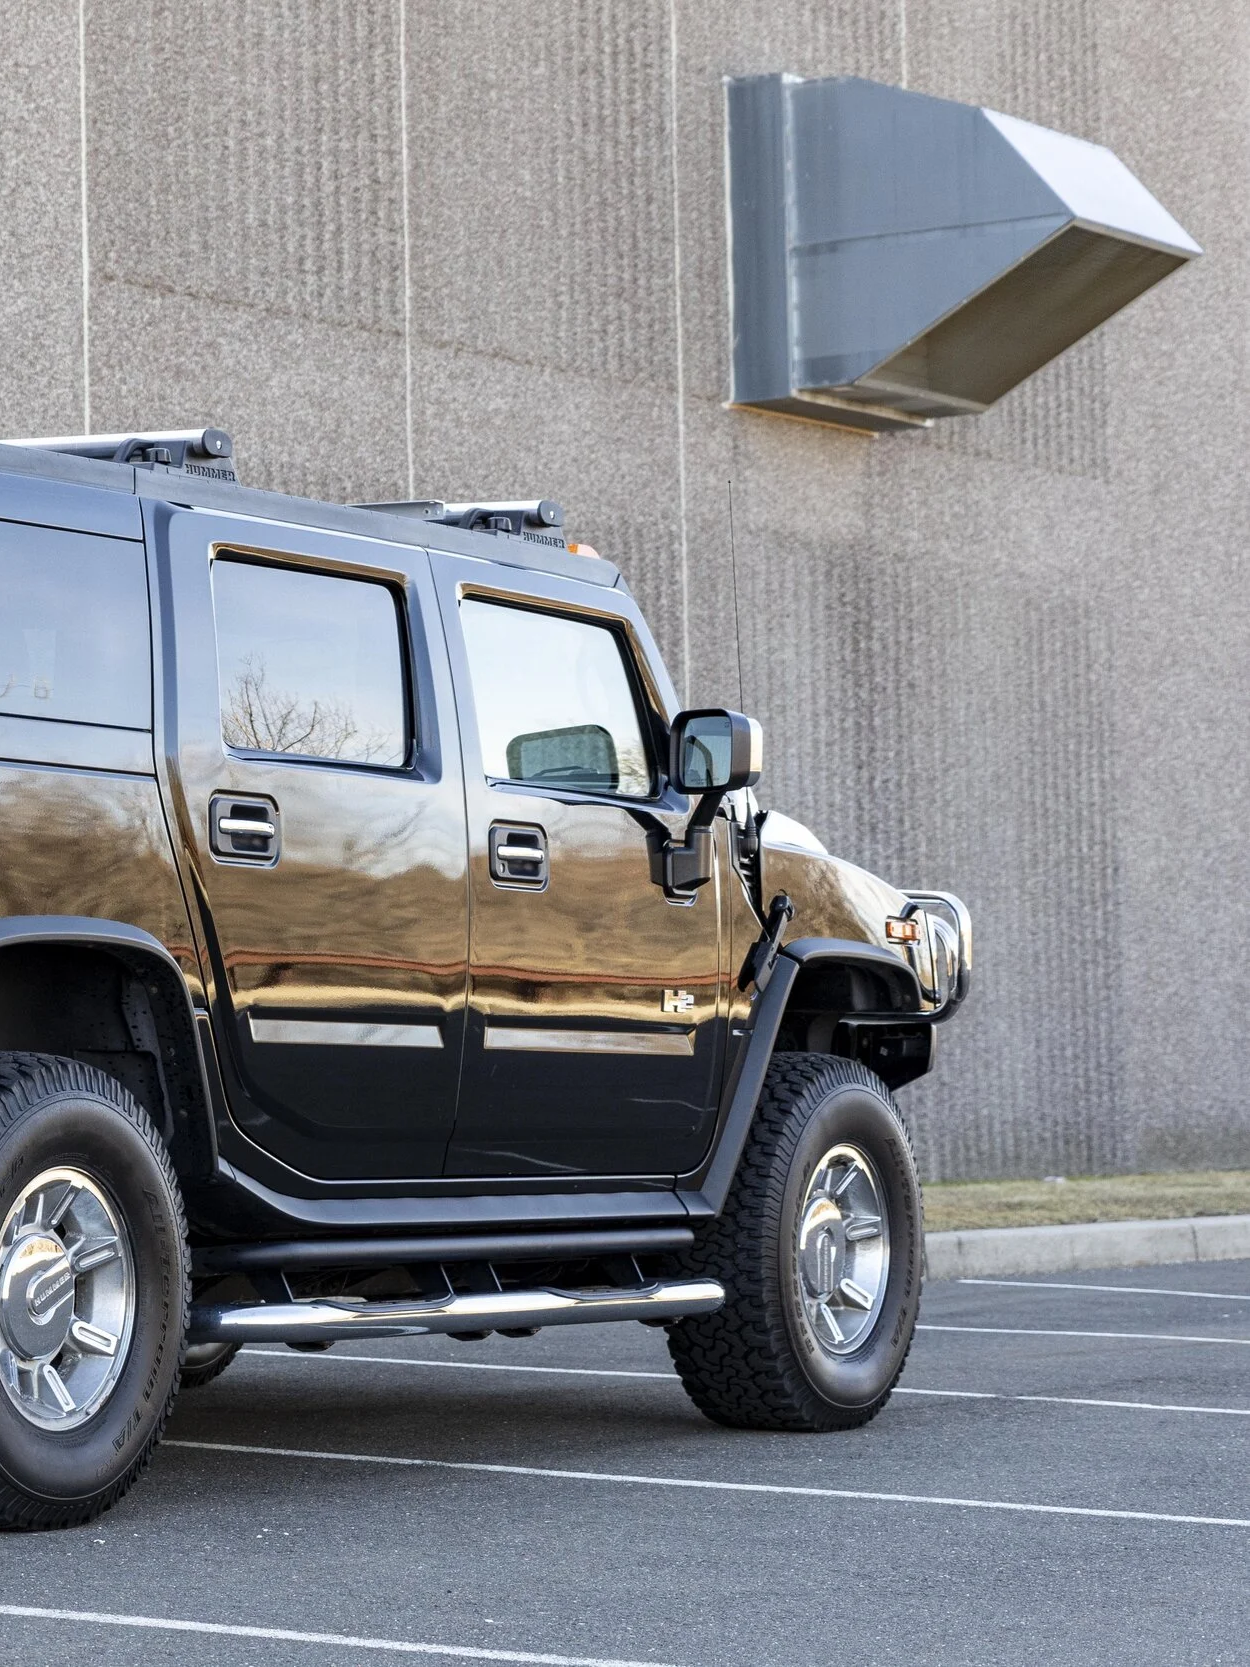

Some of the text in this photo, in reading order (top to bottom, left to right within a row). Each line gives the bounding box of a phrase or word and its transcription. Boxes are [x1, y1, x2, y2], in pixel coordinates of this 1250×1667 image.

[185, 463, 236, 481] HUMMER
[523, 531, 565, 549] HUMMER
[661, 989, 694, 1013] H2
[34, 1271, 71, 1307] HUMMER
